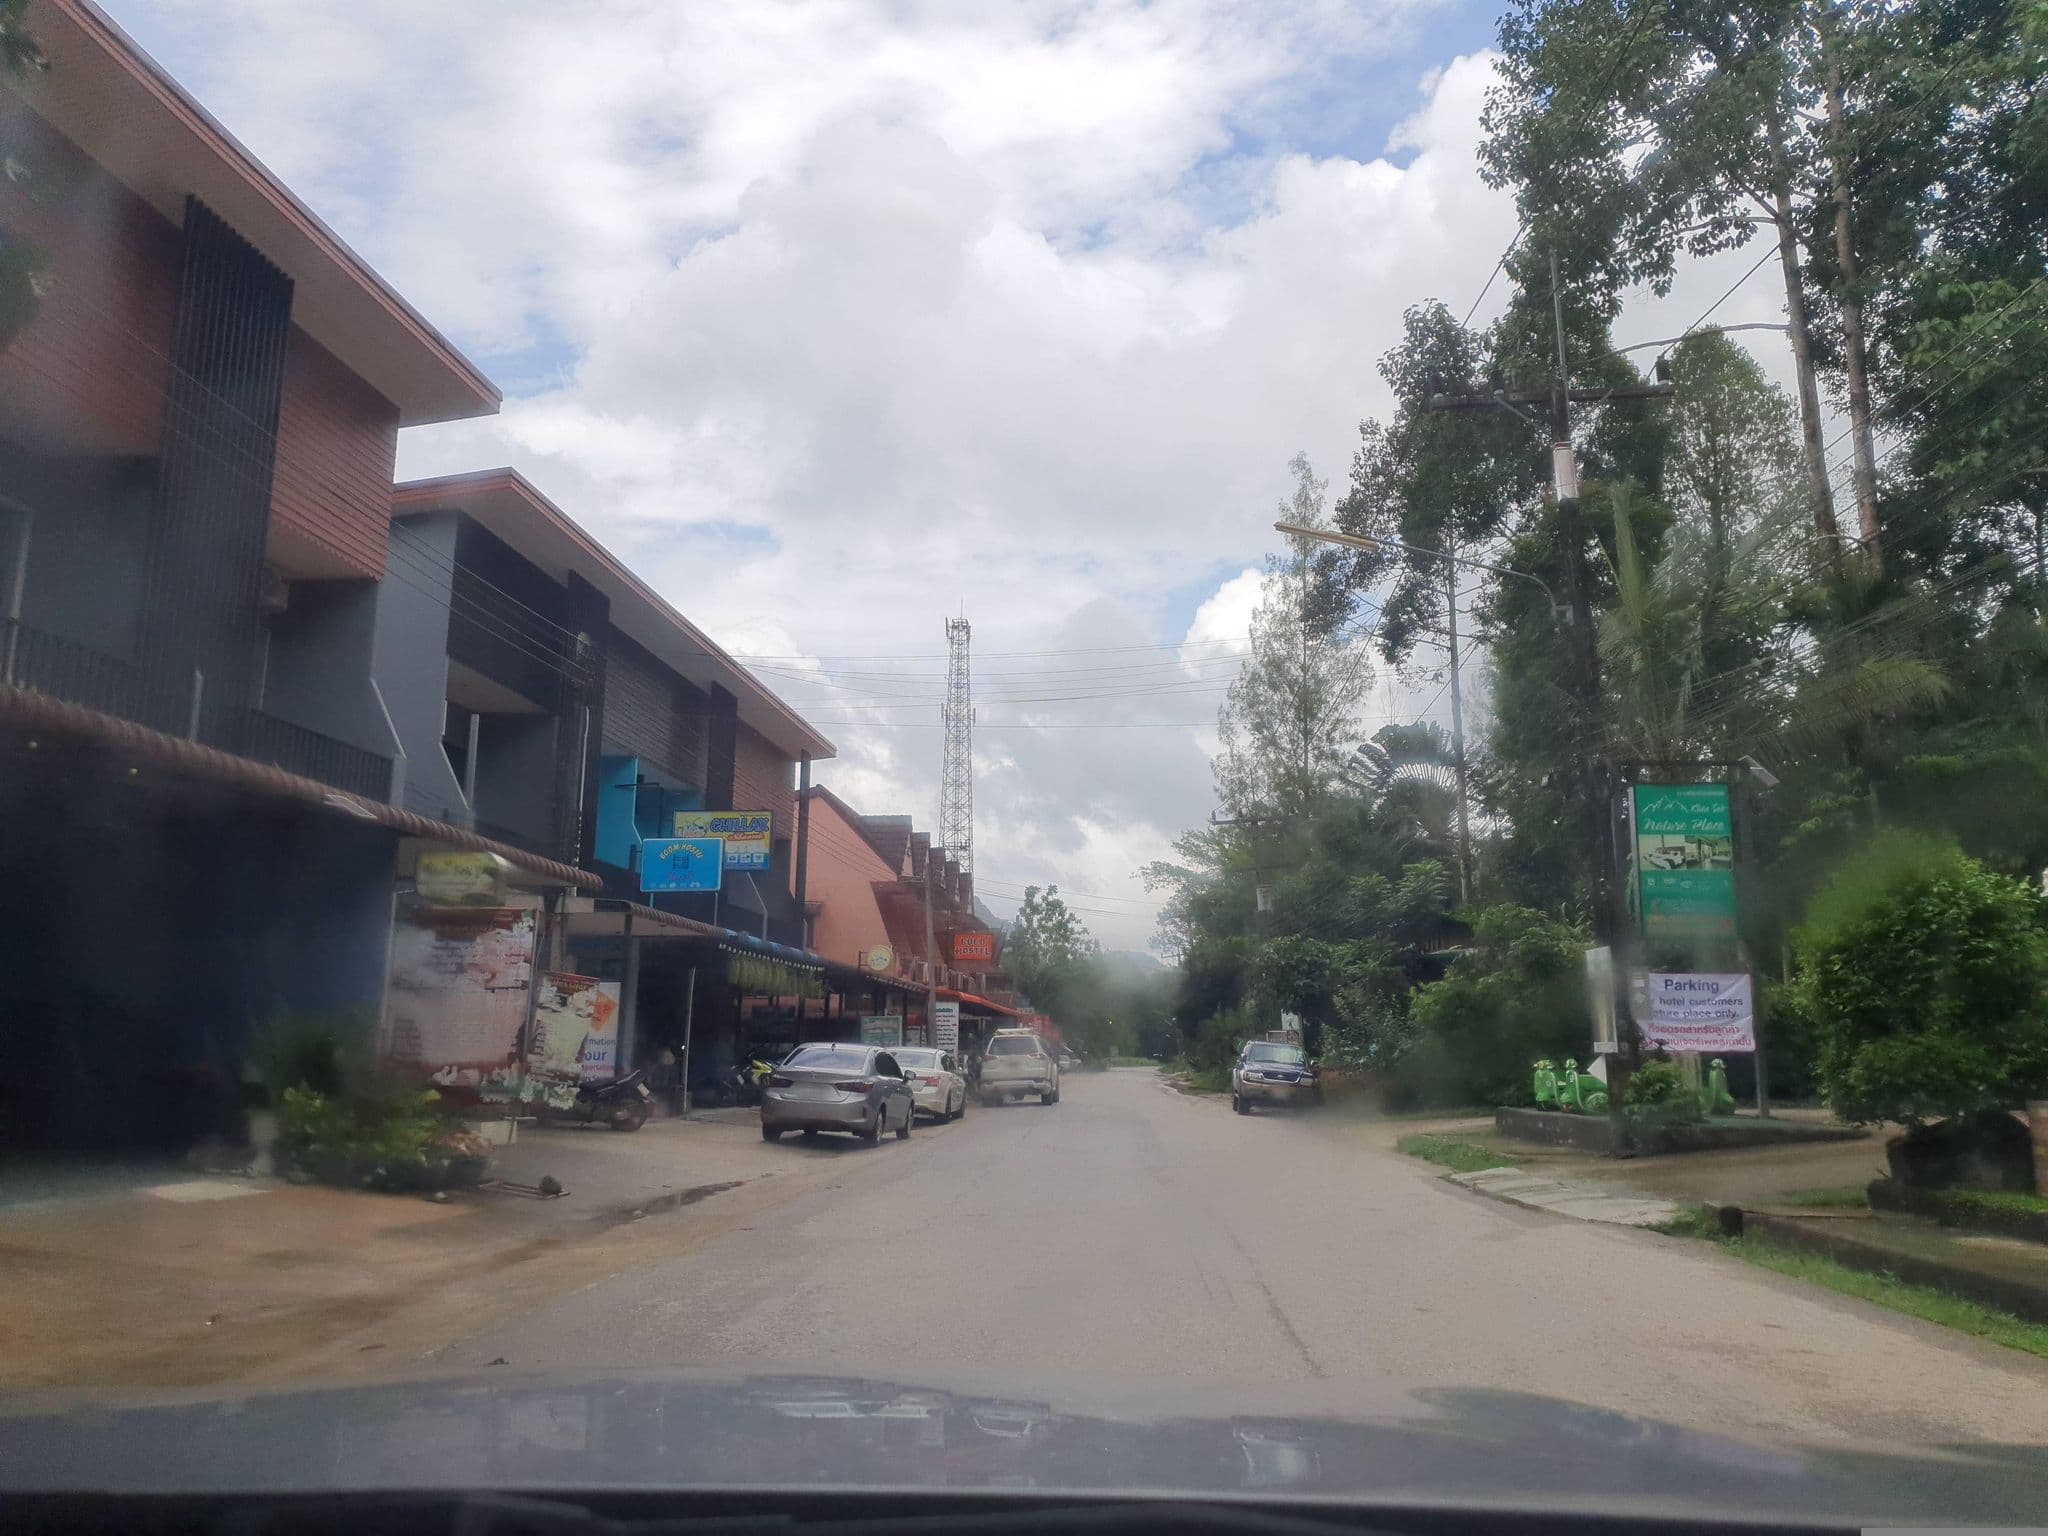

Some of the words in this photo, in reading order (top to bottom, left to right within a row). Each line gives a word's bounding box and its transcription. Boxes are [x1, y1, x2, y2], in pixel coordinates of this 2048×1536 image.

[711, 817, 770, 832] CHILLAX
[1664, 979, 1719, 993] Parking
[1659, 996, 1685, 1006] hotel
[1689, 998, 1743, 1006] customers
[1683, 1009, 1711, 1019] place
[1715, 1009, 1739, 1018] only.
